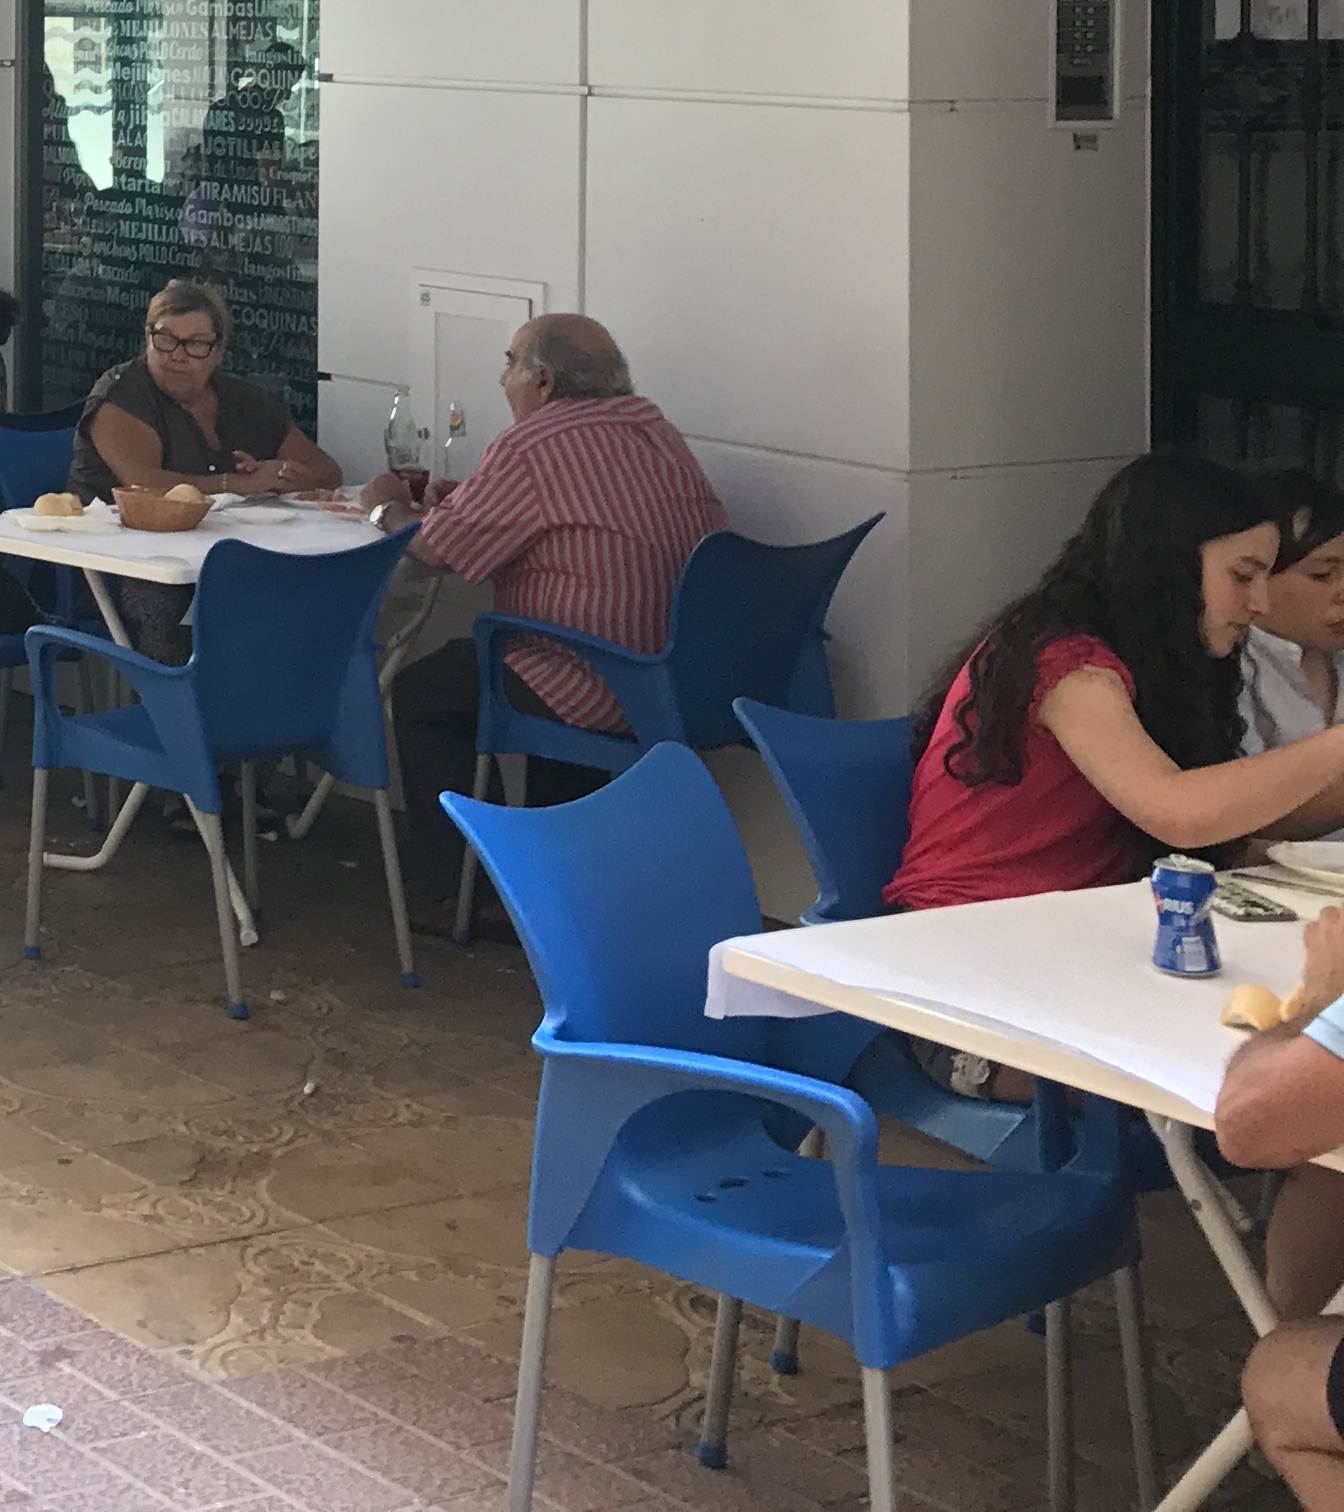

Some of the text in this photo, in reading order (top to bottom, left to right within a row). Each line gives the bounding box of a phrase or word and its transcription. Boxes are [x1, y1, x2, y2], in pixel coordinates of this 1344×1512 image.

[212, 20, 273, 42] ALMEJAS
[120, 172, 161, 195] tarta
[200, 180, 273, 206] TIRAMISÚ
[83, 191, 134, 215] Pescado
[184, 203, 254, 231] Gambas
[210, 229, 273, 256] ALMEJAS
[229, 304, 319, 337] COQUINAS
